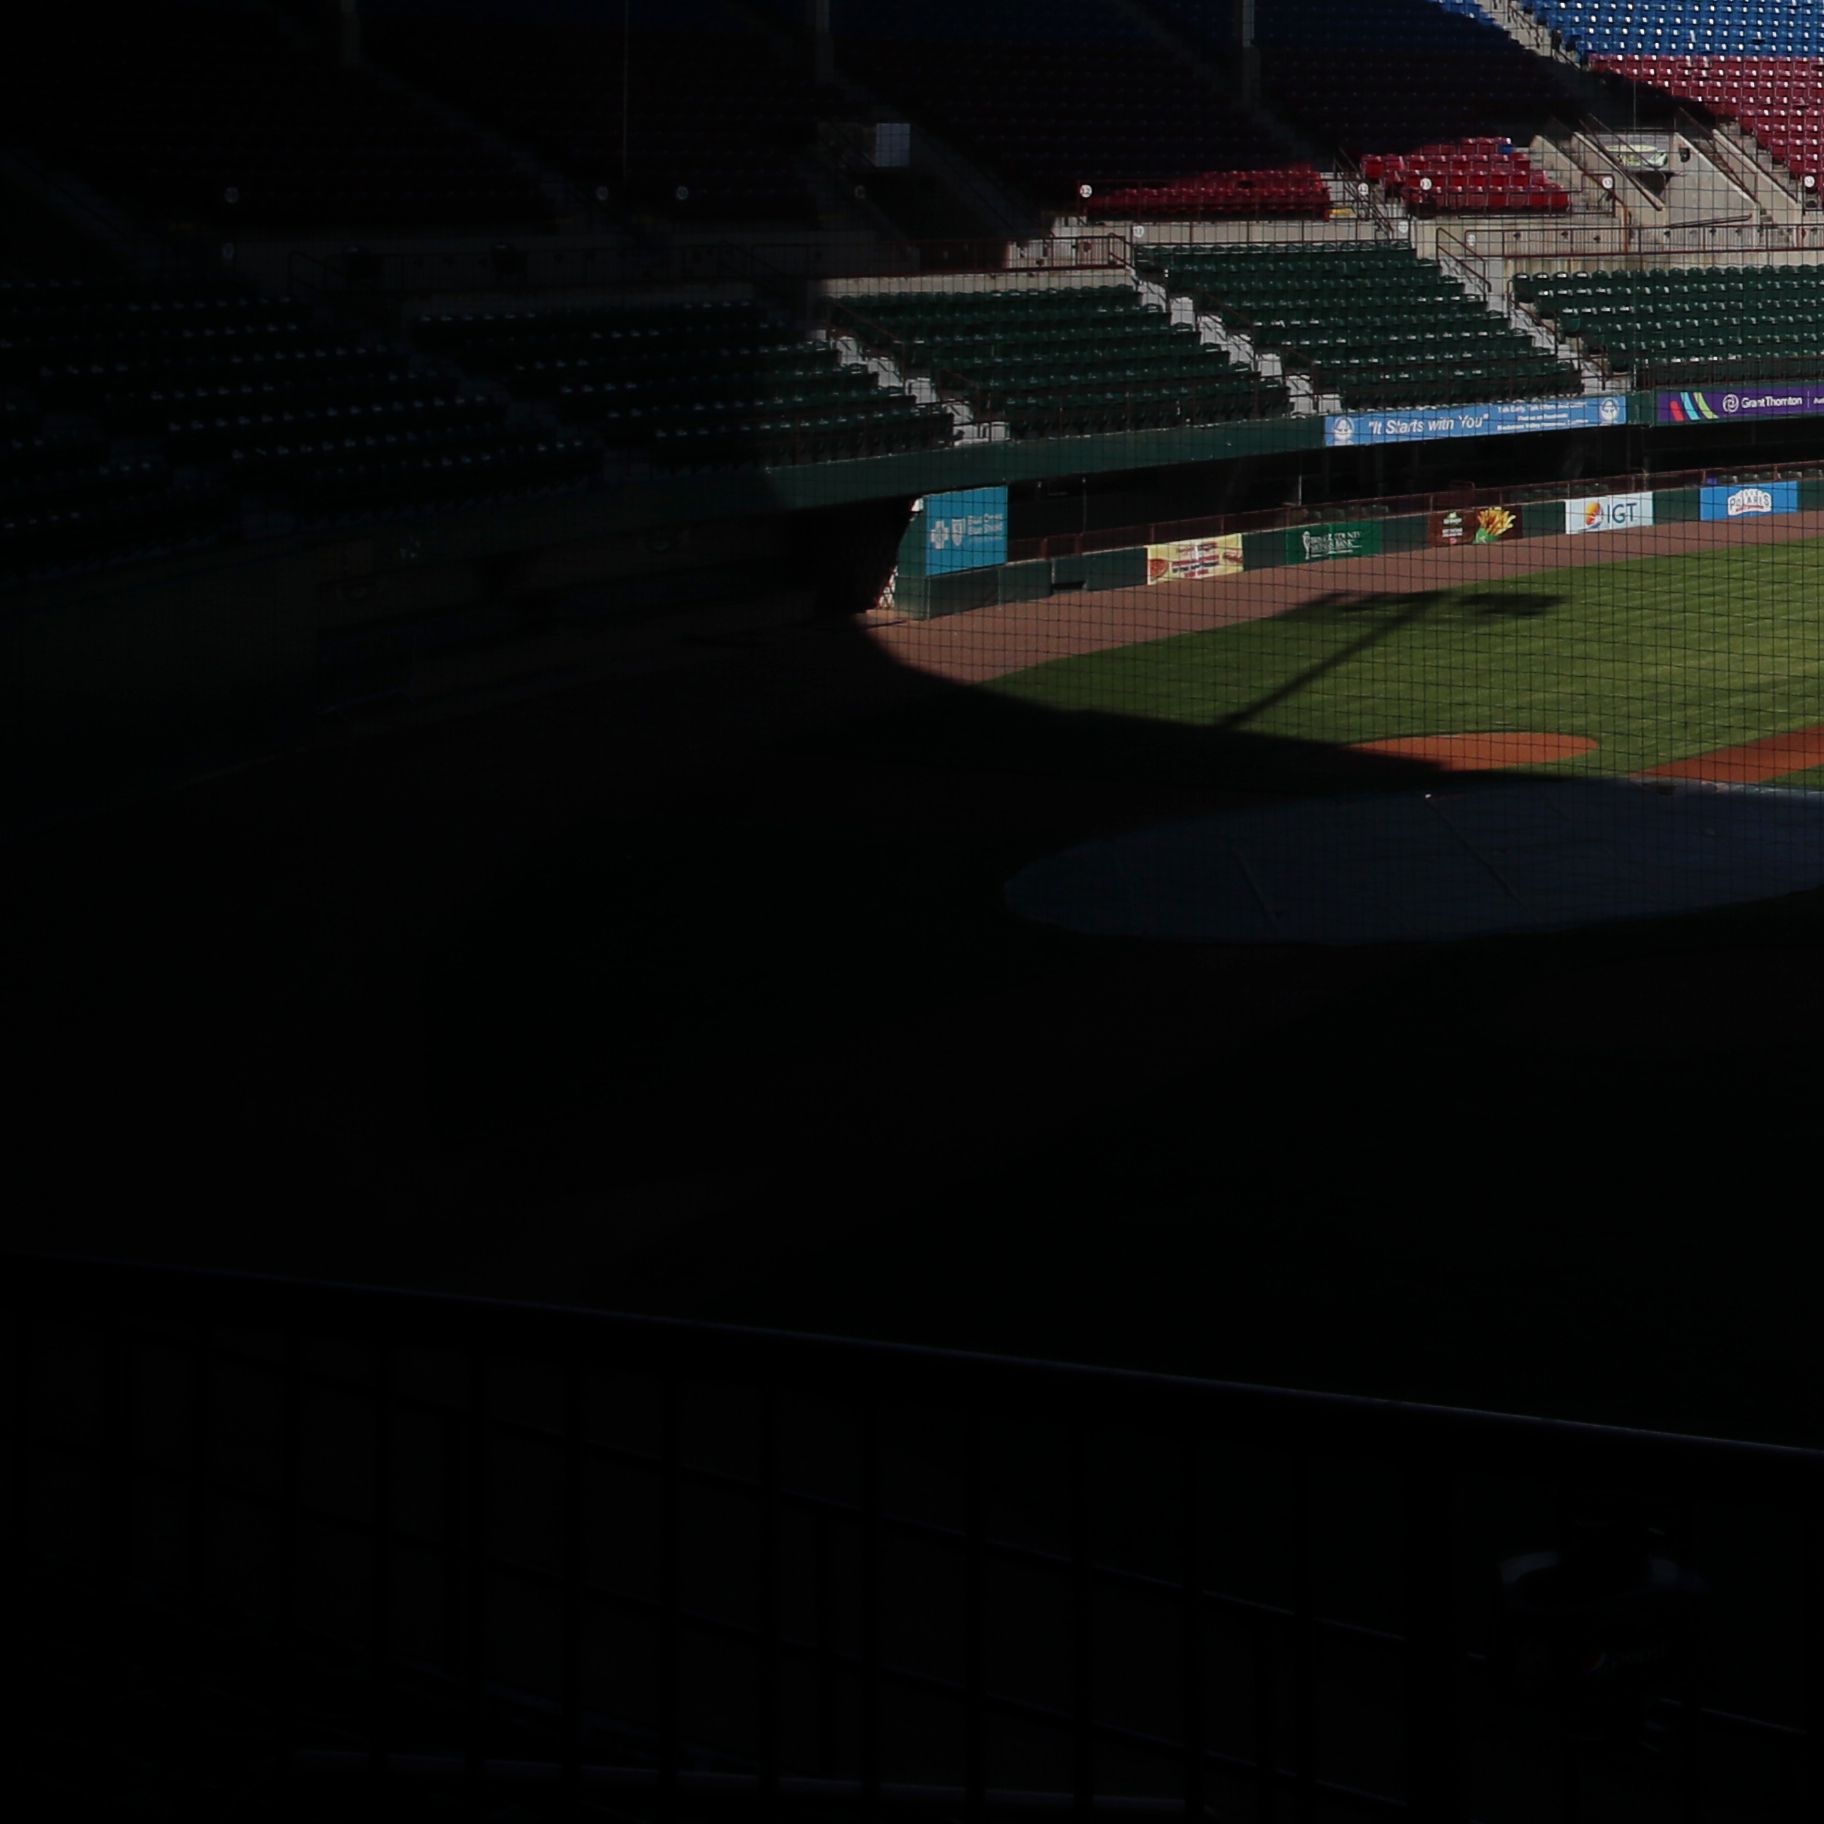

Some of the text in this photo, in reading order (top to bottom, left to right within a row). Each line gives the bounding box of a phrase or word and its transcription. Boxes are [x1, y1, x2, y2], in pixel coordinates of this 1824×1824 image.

[1385, 418, 1425, 436] Starts
[1427, 417, 1454, 432] with
[1606, 502, 1638, 525] IGT
